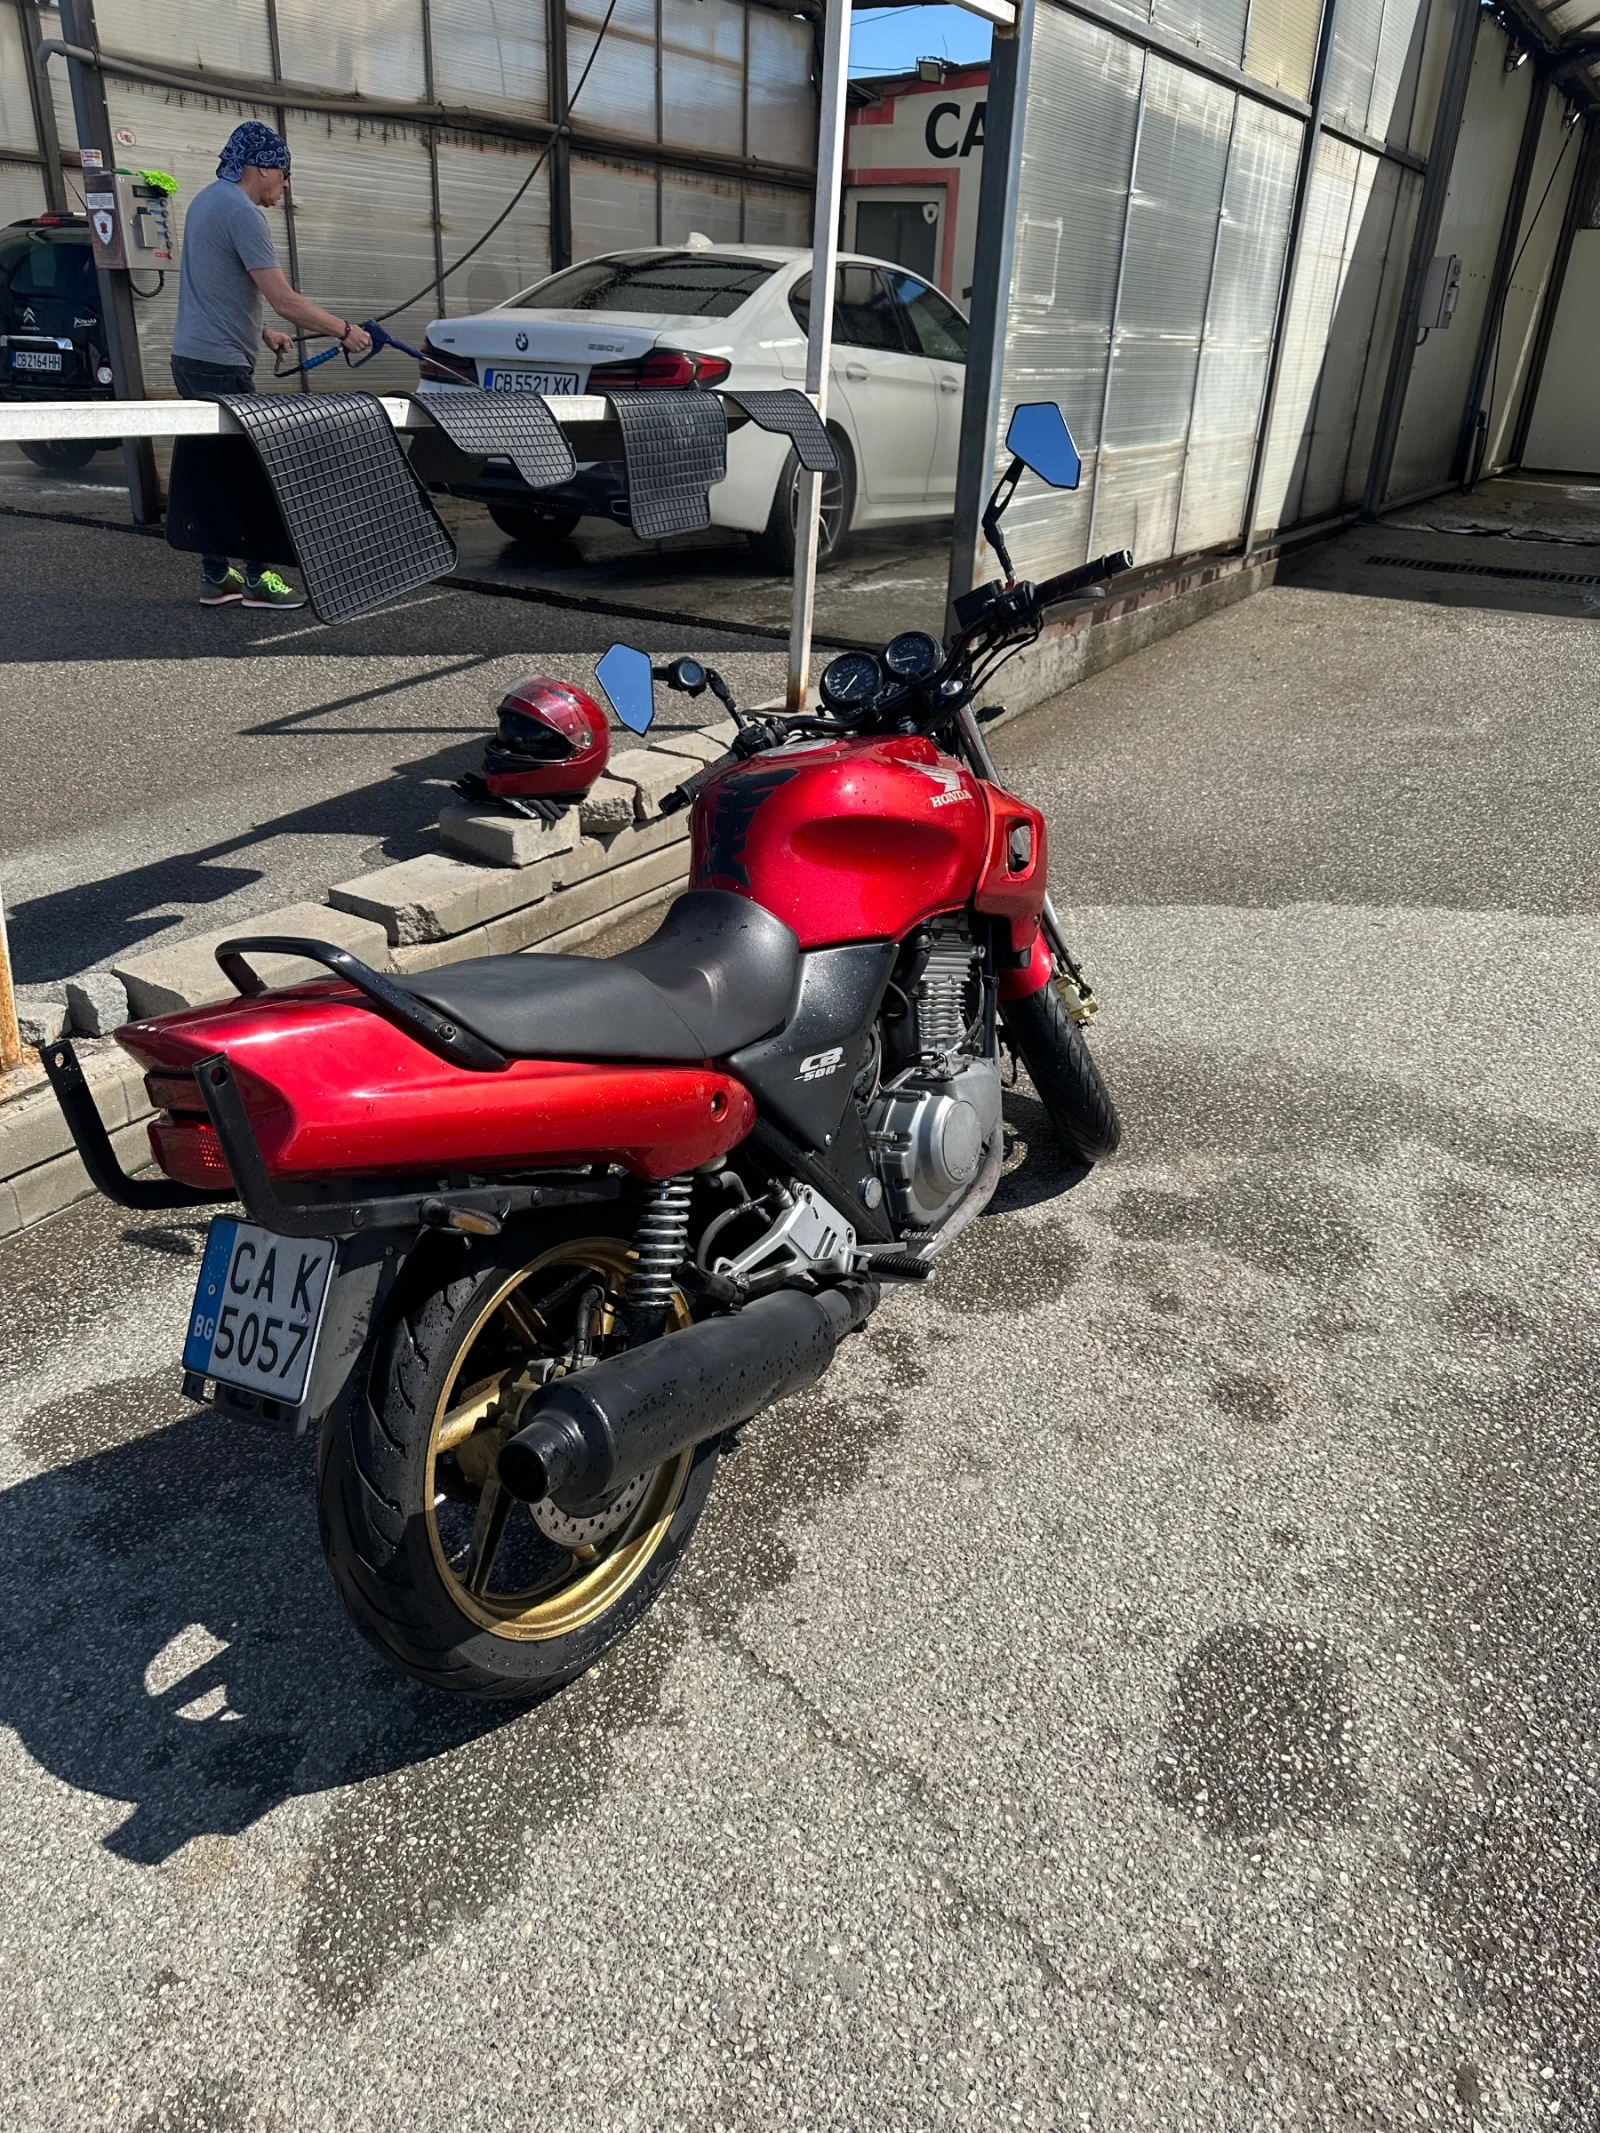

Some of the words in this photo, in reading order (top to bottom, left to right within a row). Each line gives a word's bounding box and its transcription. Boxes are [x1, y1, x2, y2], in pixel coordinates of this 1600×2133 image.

[929, 789, 973, 808] HONDA
[799, 1046, 843, 1074] CB
[803, 1064, 836, 1082] 500
[230, 1242, 277, 1304] CA
[290, 1254, 322, 1313] K
[193, 1314, 214, 1341] BG
[214, 1305, 309, 1378] 5057
